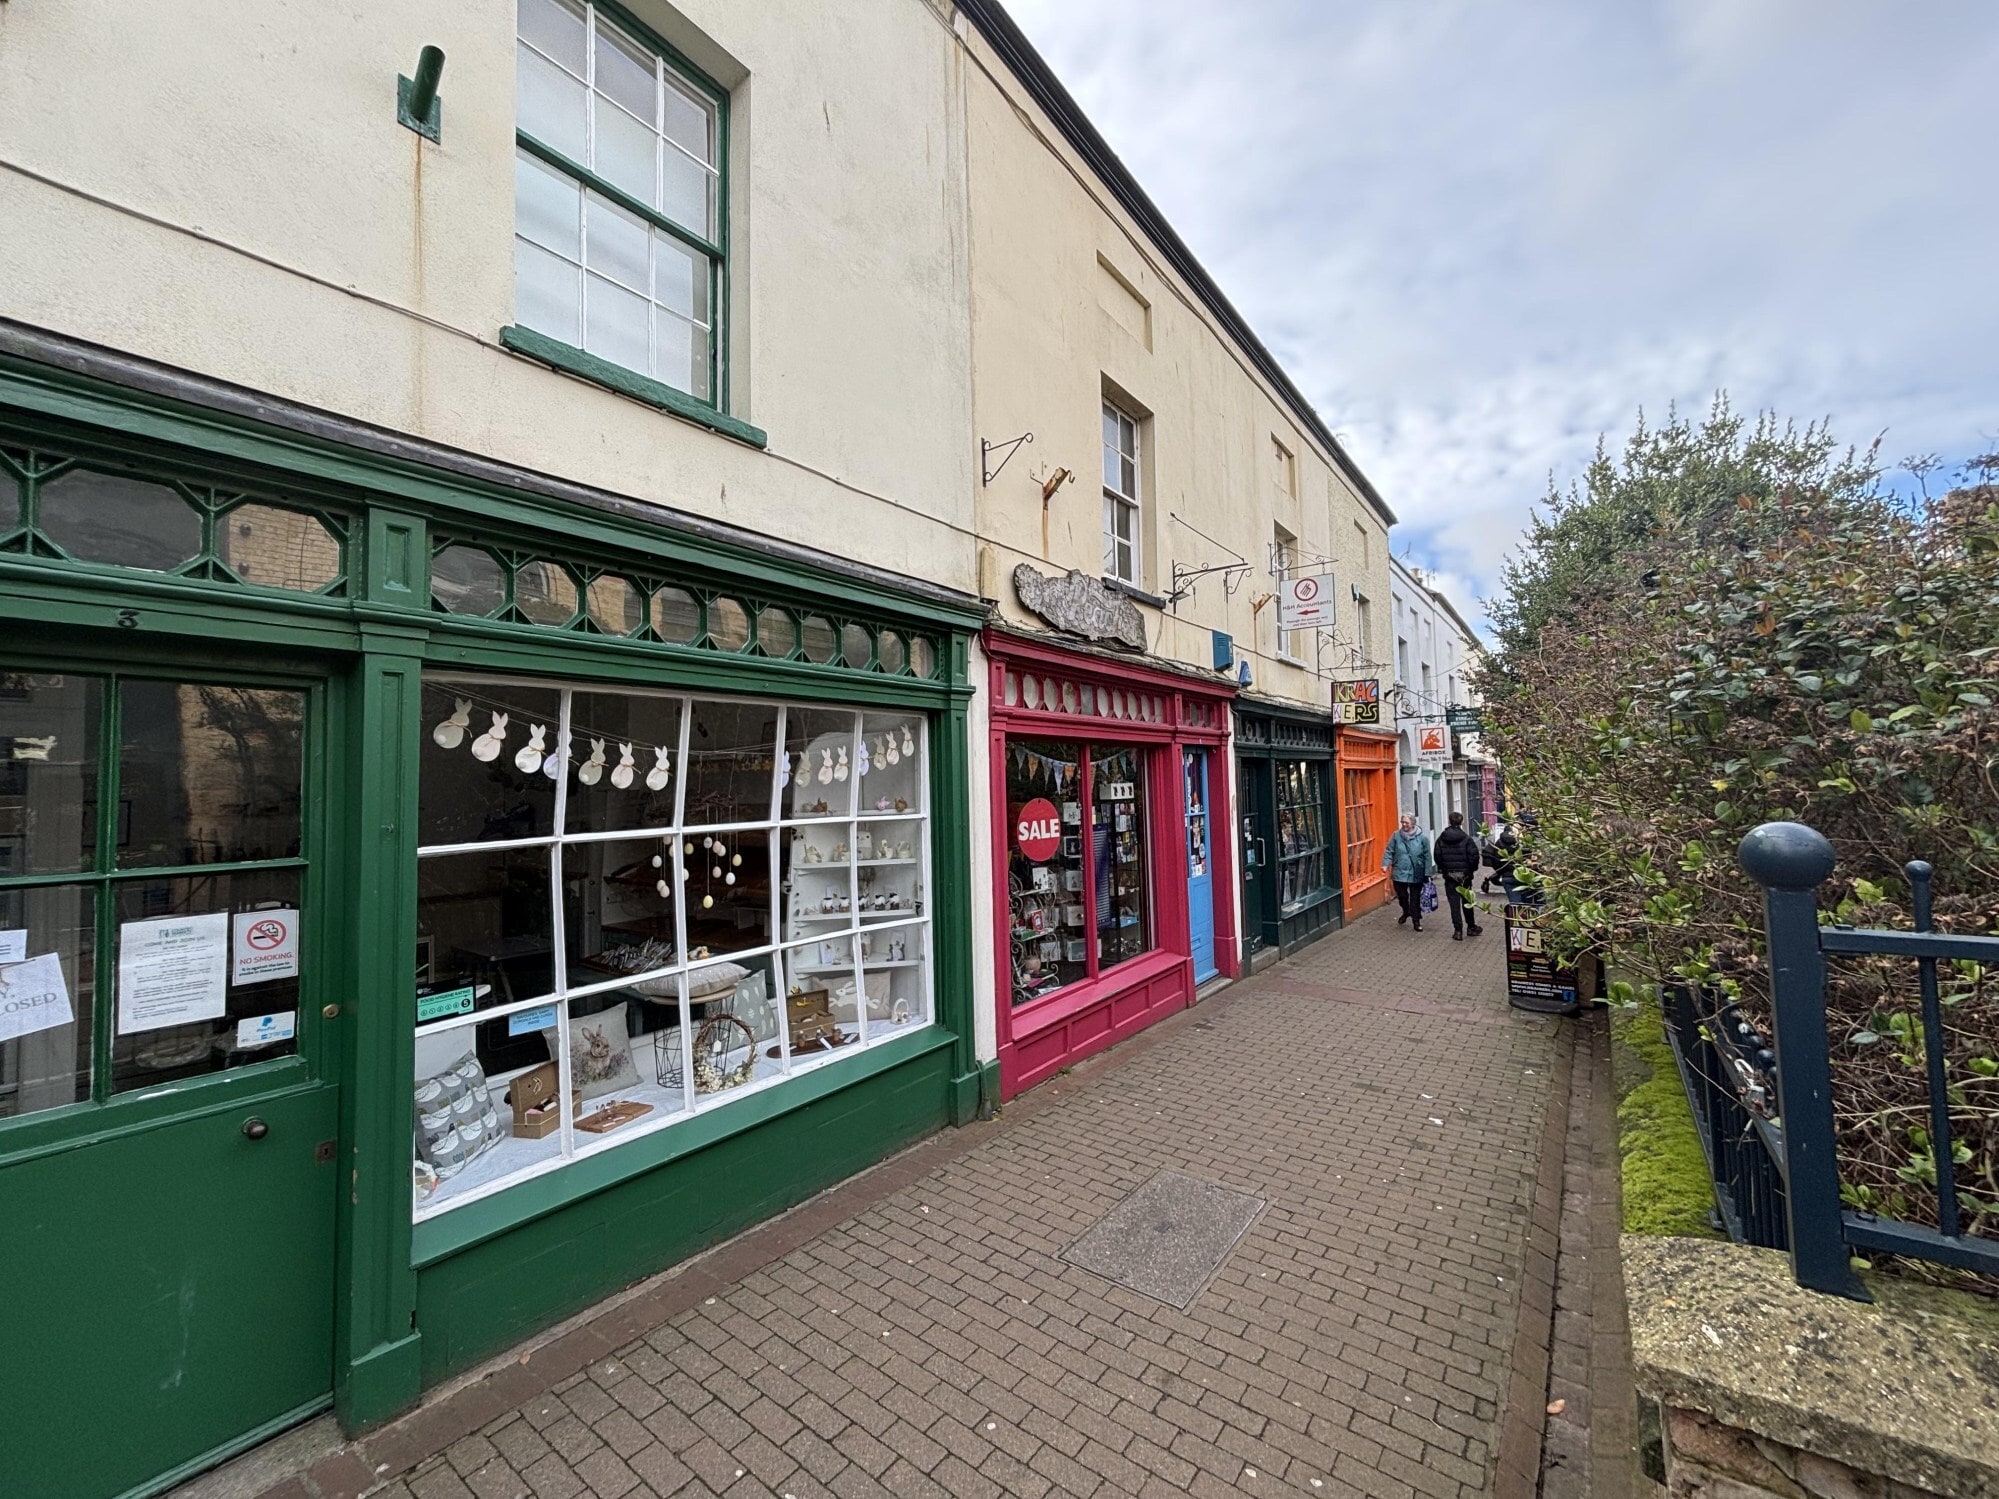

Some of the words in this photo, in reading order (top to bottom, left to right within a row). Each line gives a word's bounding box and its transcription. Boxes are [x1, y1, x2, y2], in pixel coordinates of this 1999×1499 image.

[1296, 600, 1332, 609] Accountants
[117, 609, 140, 628] 3
[1334, 681, 1378, 703] KRAC
[1333, 703, 1378, 722] KERS
[1018, 818, 1060, 841] SALE
[240, 957, 252, 965] NO
[454, 988, 471, 996] RATING
